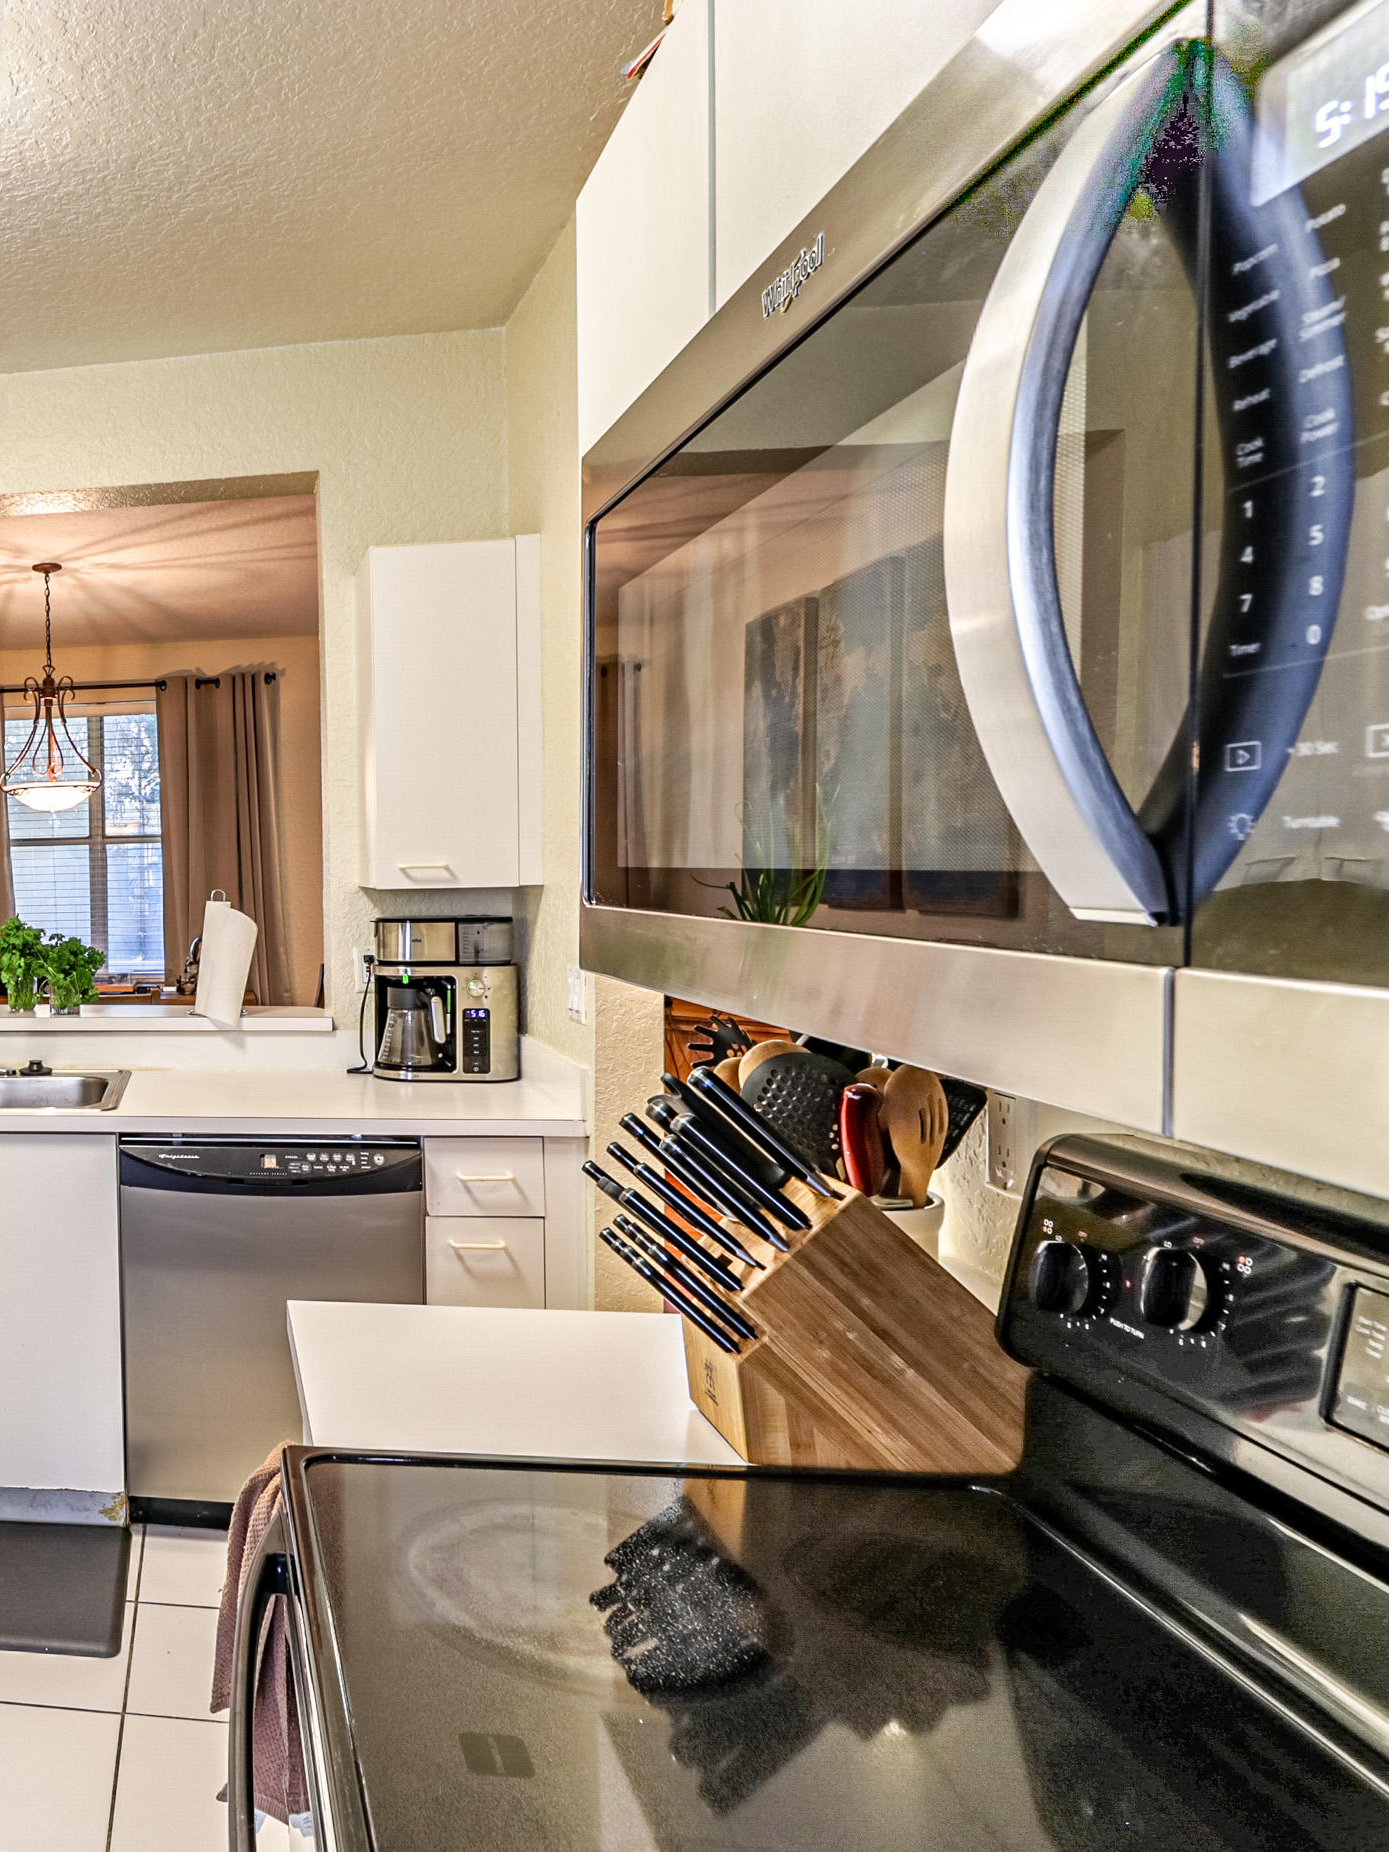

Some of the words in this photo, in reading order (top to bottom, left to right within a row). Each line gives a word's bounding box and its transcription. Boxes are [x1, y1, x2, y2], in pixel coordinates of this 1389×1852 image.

[761, 232, 824, 318] Whirlpool
[1228, 338, 1278, 369] Beverage
[1299, 354, 1345, 383] Defrost
[1232, 388, 1271, 412] Reheat
[1303, 408, 1337, 429] Cook
[1300, 421, 1339, 444] Power
[1236, 436, 1265, 455] Cook
[1236, 452, 1264, 468] Time
[1310, 475, 1326, 497] 2
[1242, 500, 1254, 518] 1
[1308, 524, 1324, 546] 5
[1239, 546, 1254, 564] 4
[1308, 575, 1324, 596] 8
[1239, 593, 1253, 613] 7
[1305, 624, 1323, 645] 0
